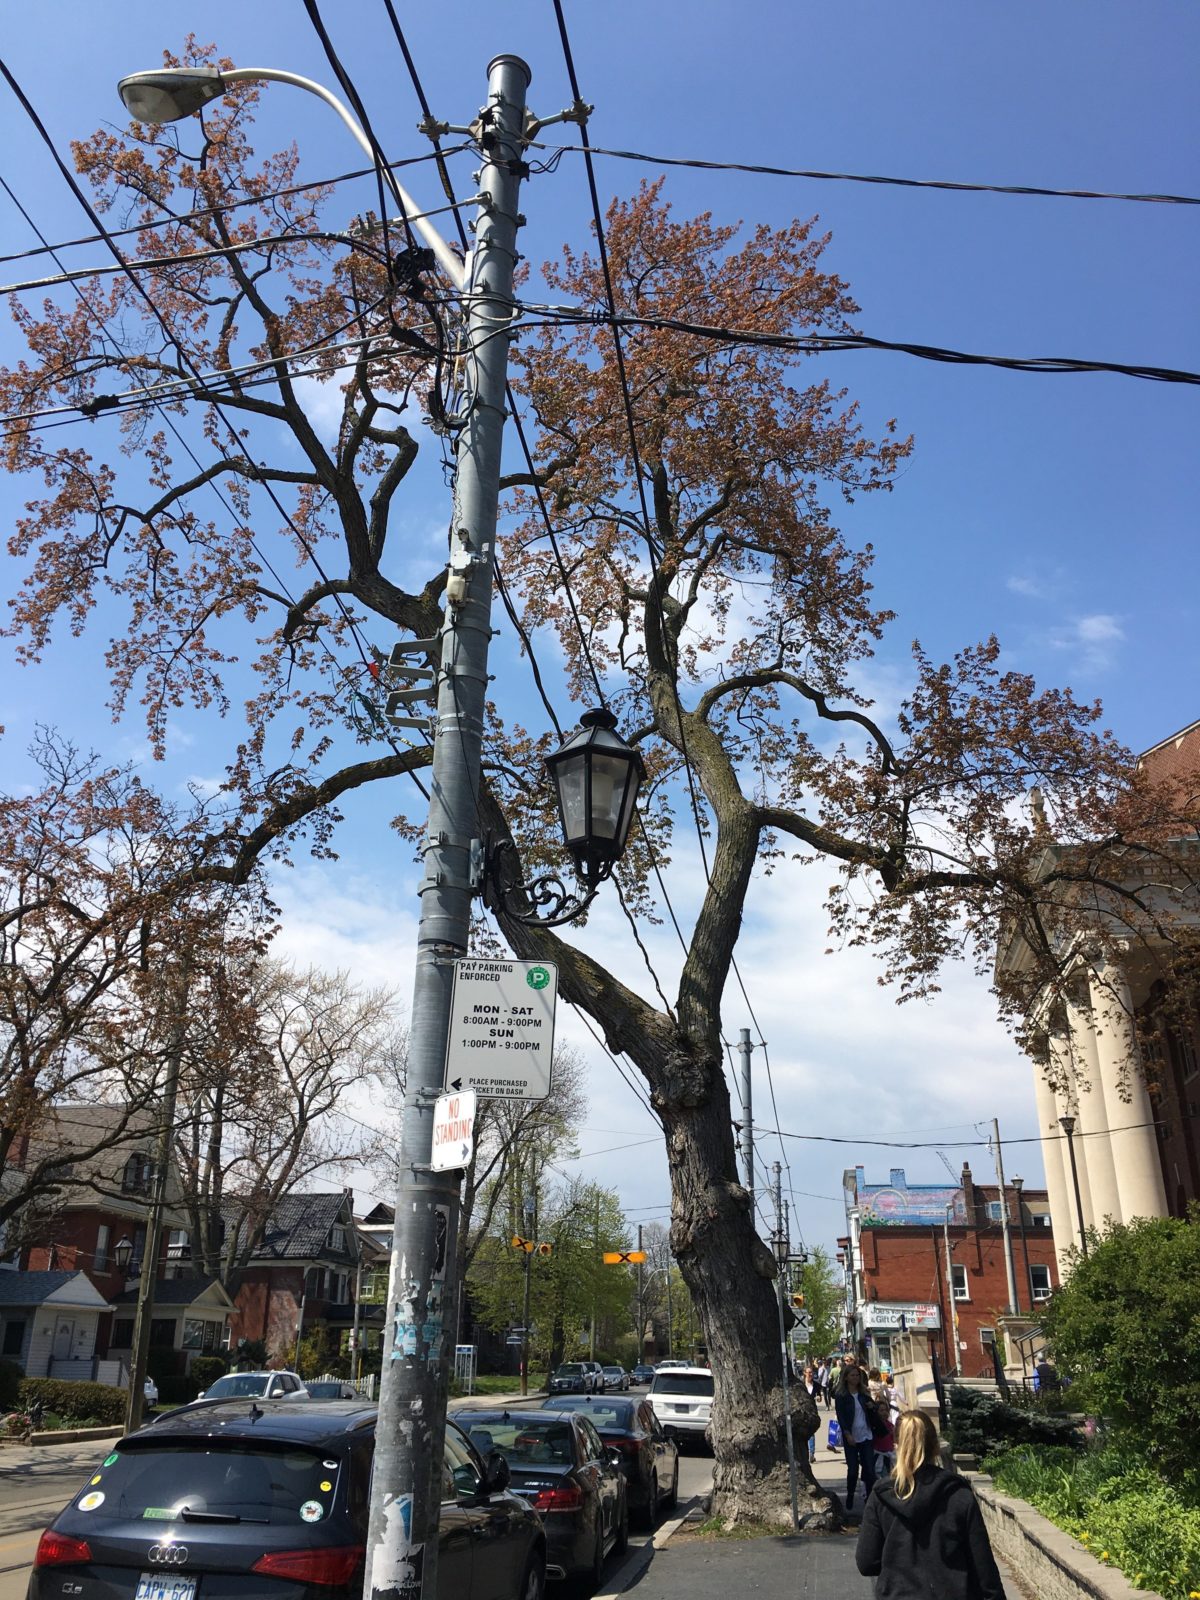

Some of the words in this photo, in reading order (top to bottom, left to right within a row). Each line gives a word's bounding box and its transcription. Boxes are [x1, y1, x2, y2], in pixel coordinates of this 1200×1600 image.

[460, 963, 476, 971] PAY
[478, 963, 513, 973] PARKING
[460, 972, 500, 982] ENFORCED
[533, 972, 545, 984] P
[473, 1005, 500, 1014] MON
[511, 1006, 534, 1015] SAT
[463, 1016, 499, 1025] 8:00AM
[507, 1018, 542, 1027] 9:00PM
[489, 1028, 514, 1038] SUN
[462, 1039, 497, 1049] 1:00PM
[505, 1041, 540, 1050] 9:00PM
[469, 1078, 489, 1086] PLACE
[490, 1078, 528, 1087] PURCHASED
[448, 1098, 460, 1119] NO
[435, 1118, 473, 1146] STANDING
[876, 1315, 890, 1323] Gift
